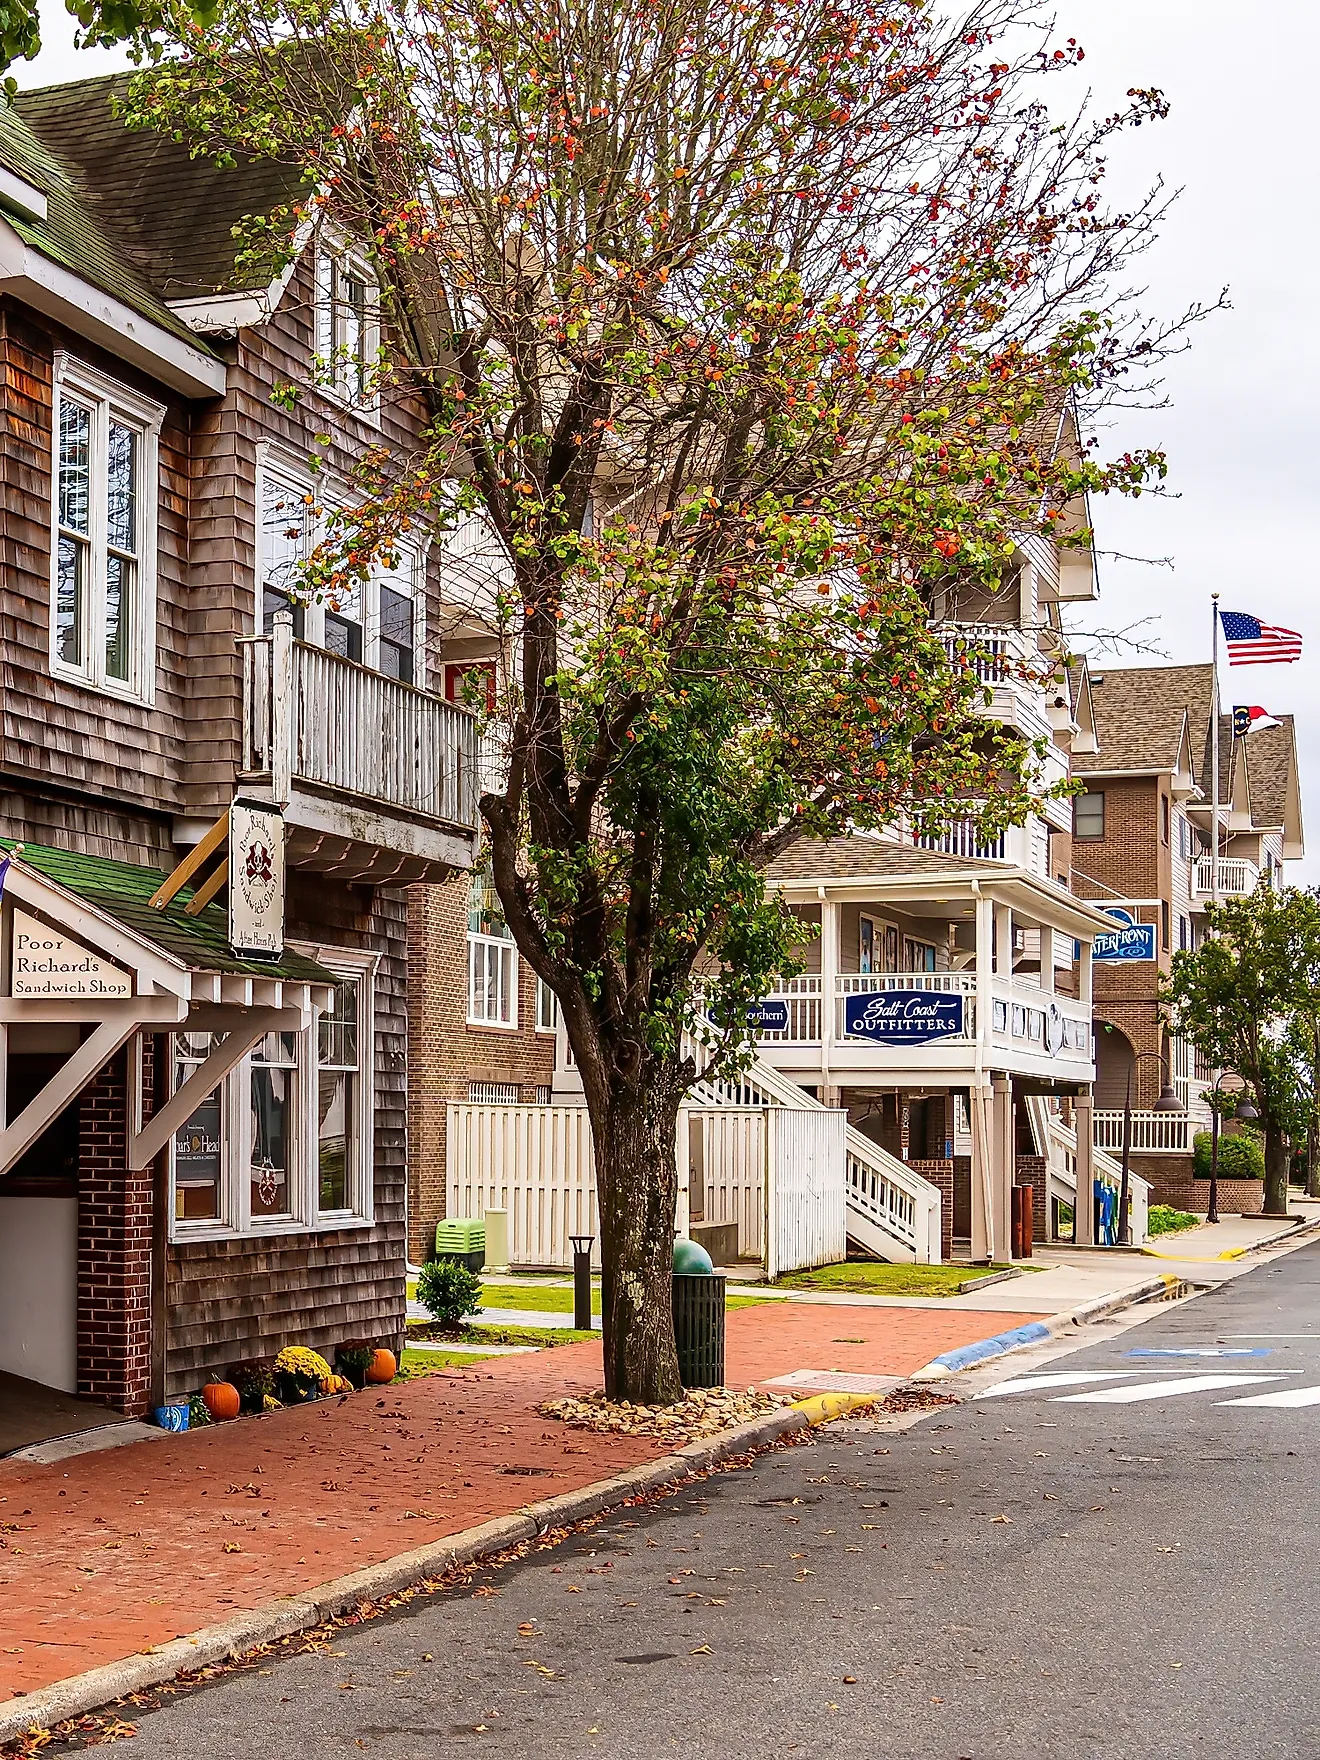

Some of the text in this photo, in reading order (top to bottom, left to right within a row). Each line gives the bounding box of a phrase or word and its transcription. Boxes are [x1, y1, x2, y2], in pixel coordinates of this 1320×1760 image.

[17, 934, 64, 950] Poor
[1091, 928, 1151, 956] ATERFRONT
[16, 957, 100, 973] Richard's
[15, 979, 127, 995] Sandwich Shop
[862, 997, 958, 1020] Salt Coast
[852, 1019, 956, 1031] OUTFITTERS
